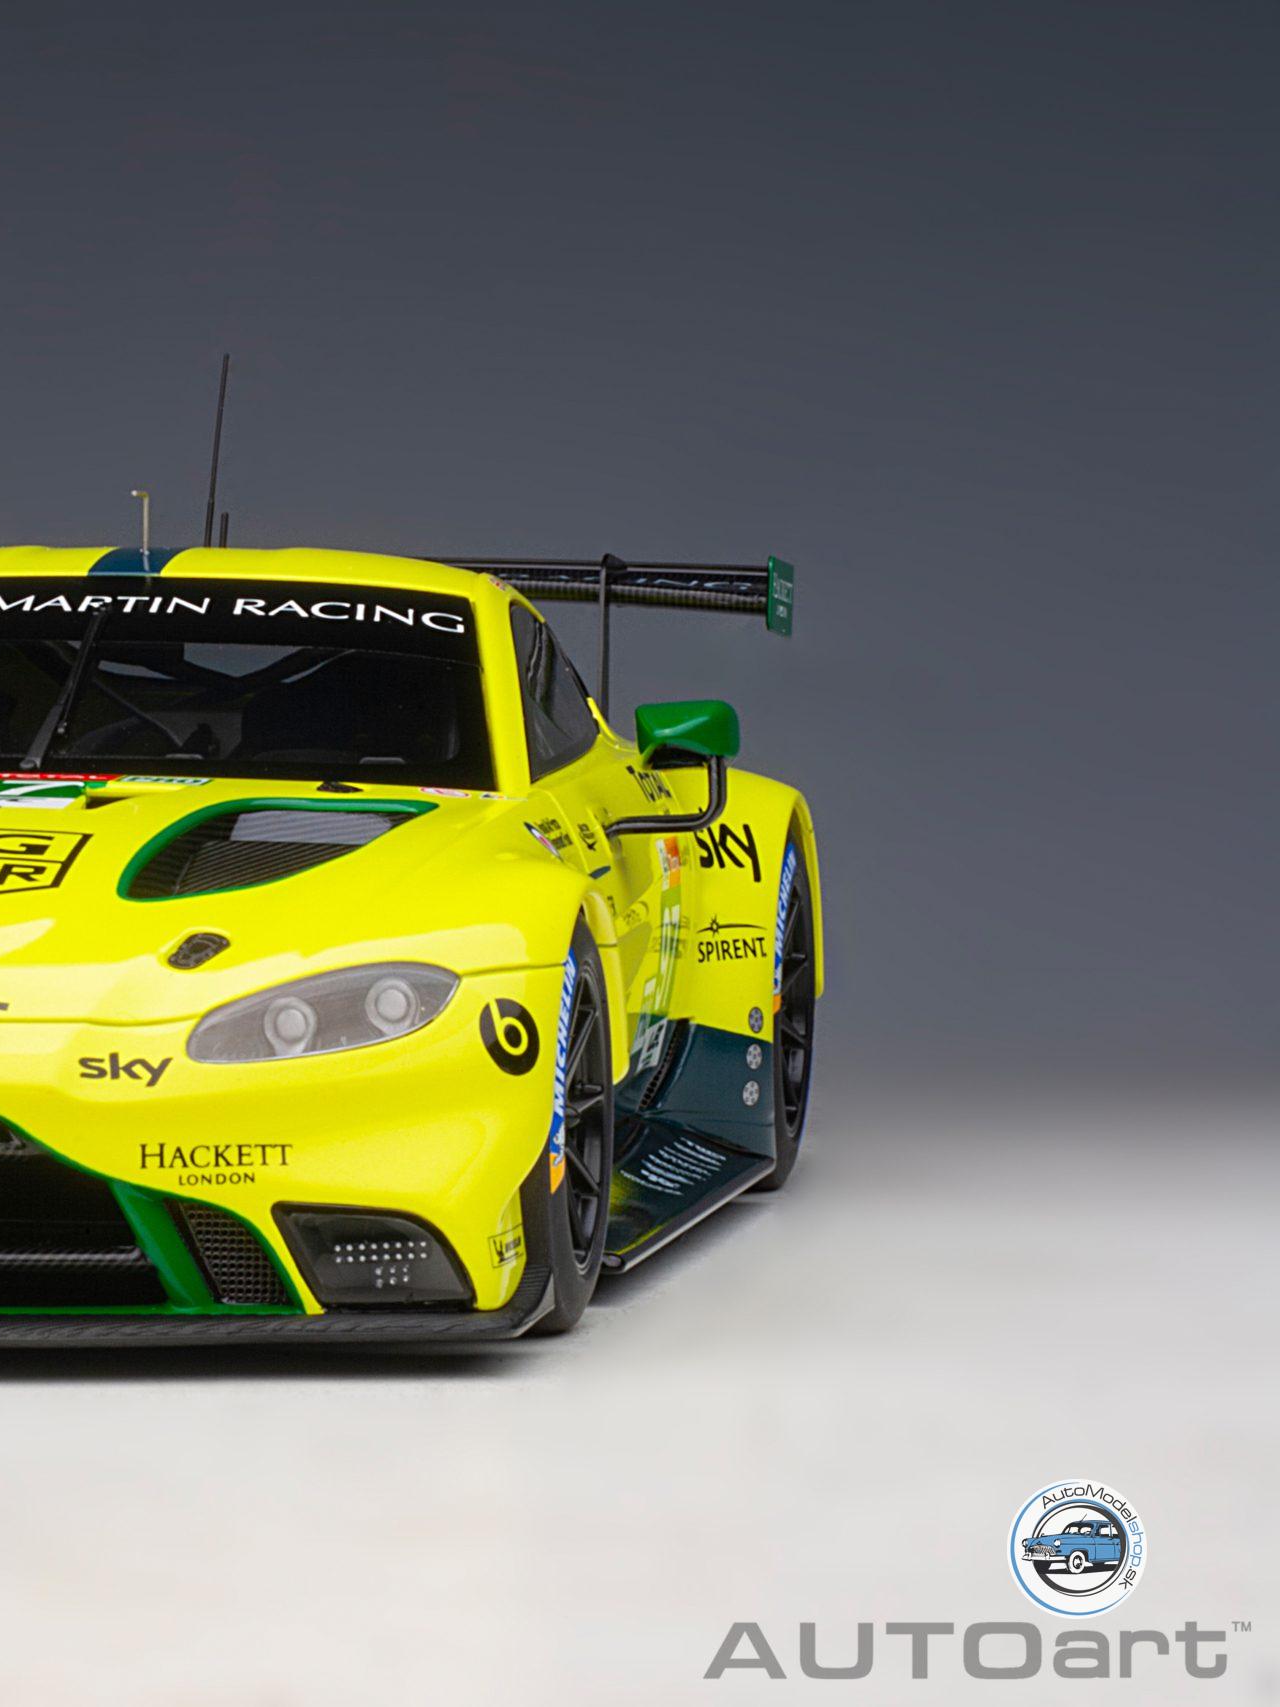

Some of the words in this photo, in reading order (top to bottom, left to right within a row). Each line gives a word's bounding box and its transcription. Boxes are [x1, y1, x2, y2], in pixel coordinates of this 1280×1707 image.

[232, 598, 466, 634] RACING
[694, 807, 761, 883] sky
[78, 1052, 173, 1087] sky
[139, 1143, 293, 1169] HACKETT
[179, 1172, 256, 1185] LONDON
